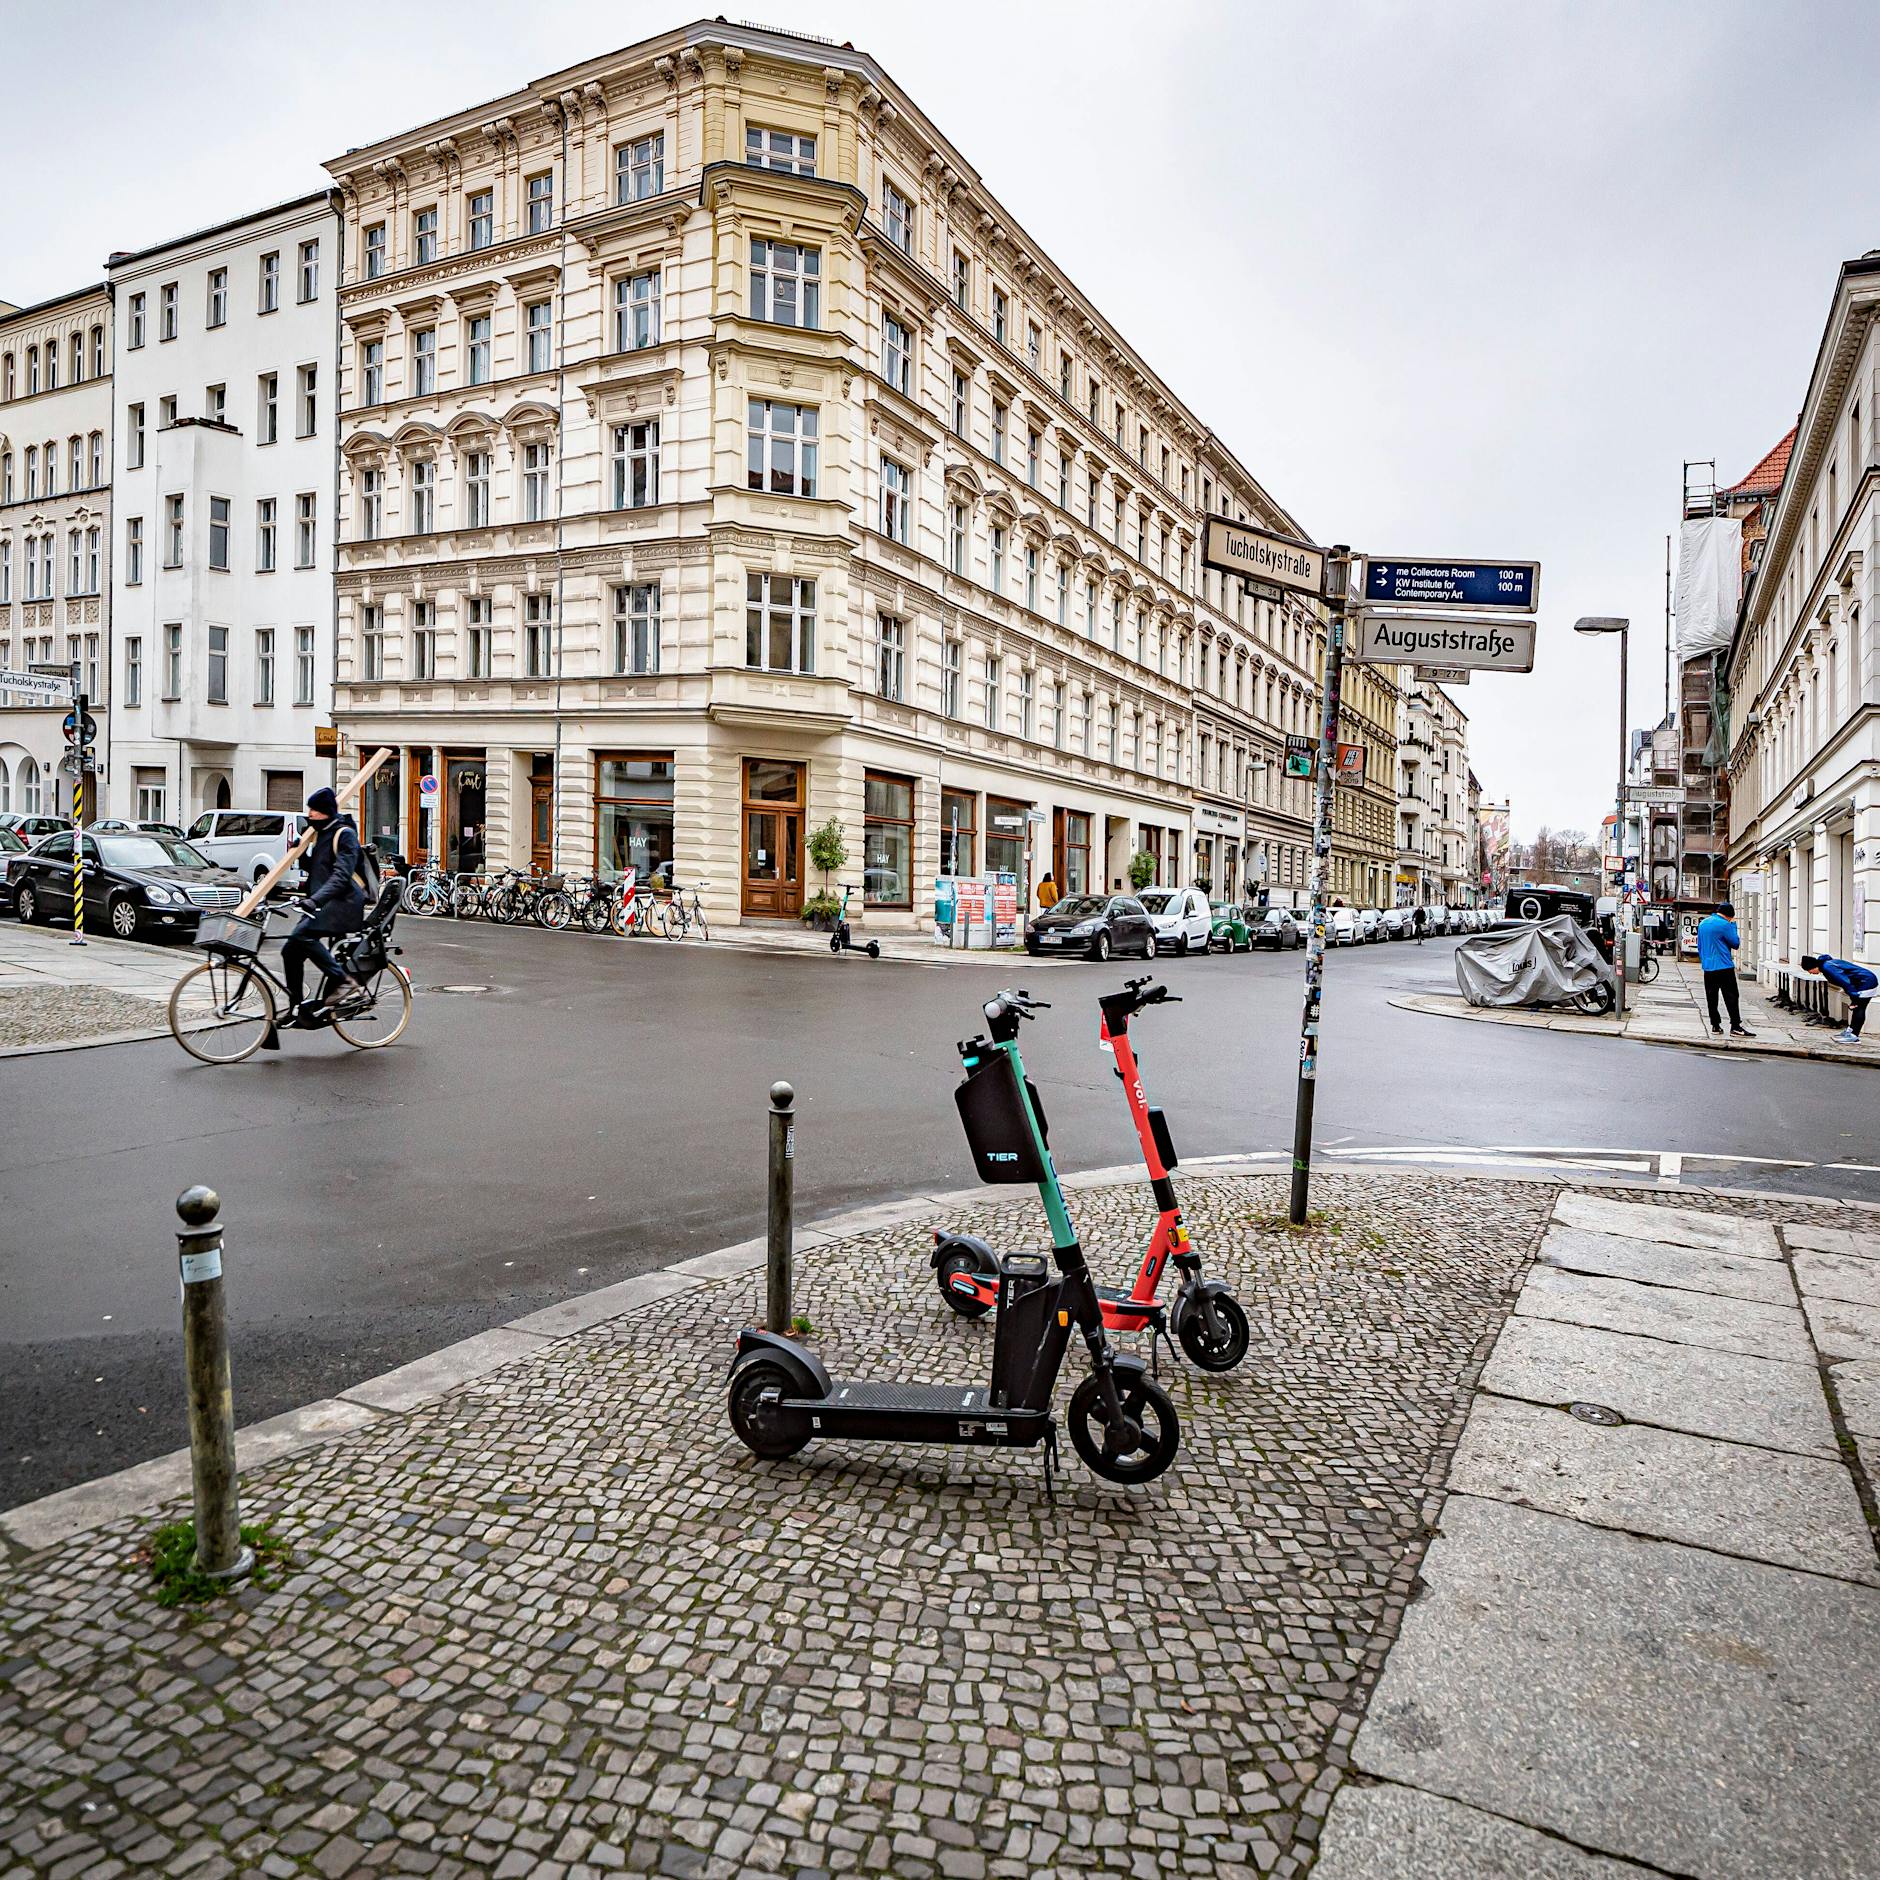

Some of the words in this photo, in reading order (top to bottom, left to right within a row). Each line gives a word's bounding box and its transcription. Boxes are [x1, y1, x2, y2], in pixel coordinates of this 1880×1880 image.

[1226, 530, 1311, 578] Tucholskystraße
[1396, 568, 1409, 576] me
[1410, 567, 1450, 577] Collectors
[1451, 569, 1476, 578] Room
[1498, 570, 1514, 579] 100
[1515, 572, 1524, 580] m
[1395, 578, 1411, 587] KW
[1412, 579, 1442, 588] Institute
[1443, 580, 1456, 589] for
[1497, 582, 1513, 591] 100
[1514, 584, 1523, 592] m
[1268, 588, 1277, 597] 34
[1395, 588, 1451, 600] Contemporary
[1450, 590, 1463, 599] Art
[1374, 623, 1515, 657] Auguststraße
[629, 836, 648, 848] HAY
[876, 854, 890, 864] HAY
[986, 1152, 1019, 1162] TIER
[1006, 1279, 1016, 1309] TIER
